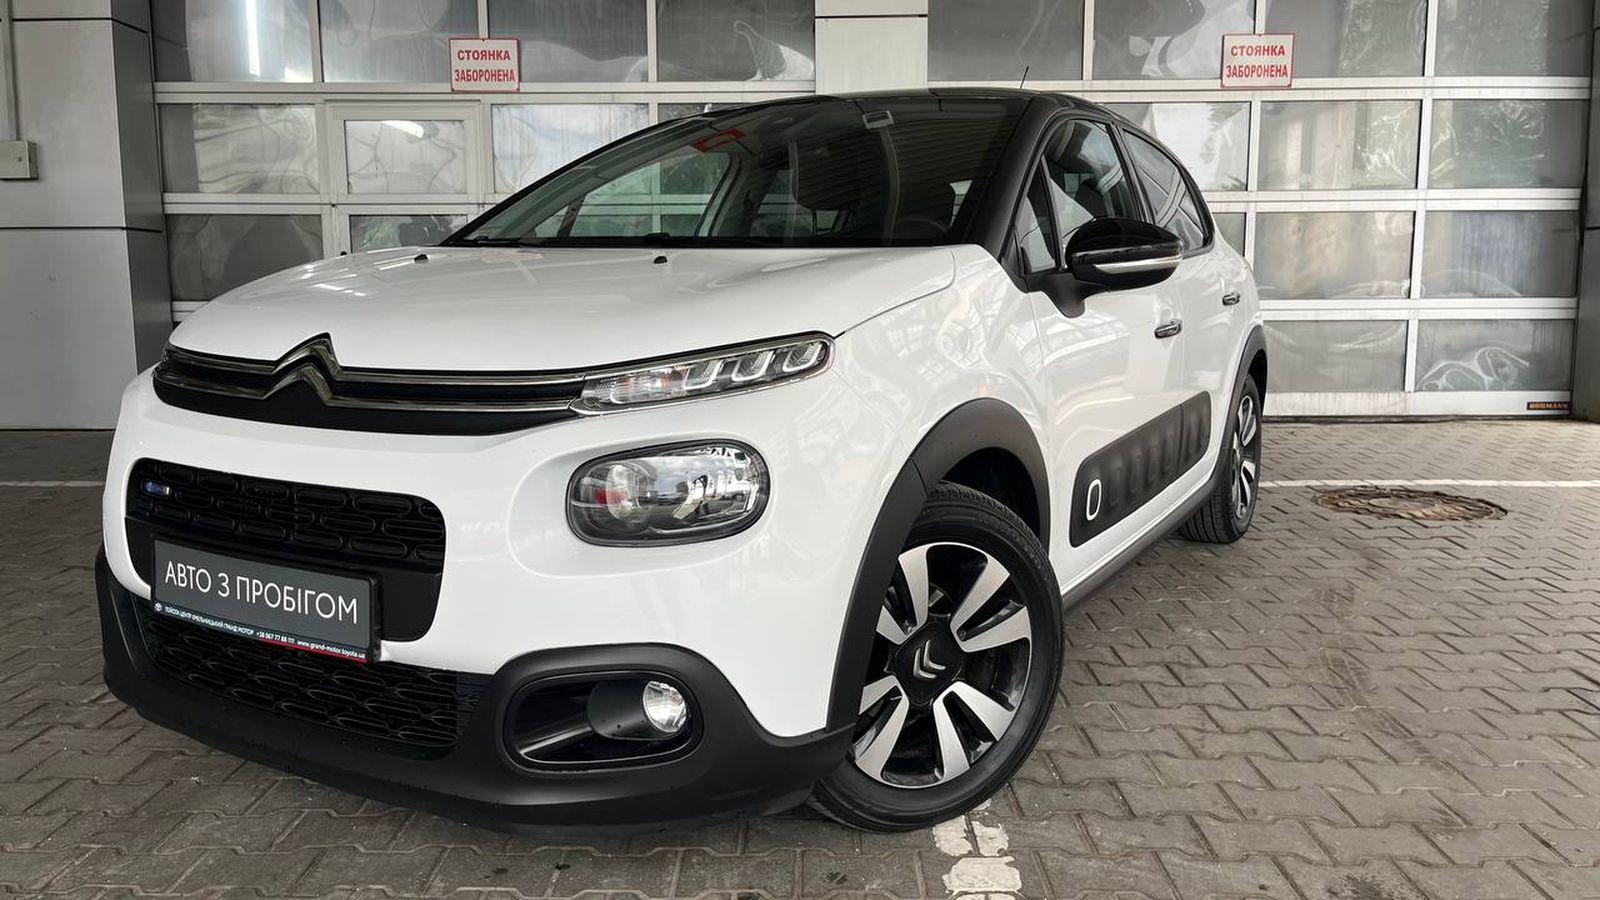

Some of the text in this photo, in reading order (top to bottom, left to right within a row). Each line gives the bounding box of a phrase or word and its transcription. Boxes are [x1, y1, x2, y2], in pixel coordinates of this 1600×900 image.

[457, 49, 511, 61] СТОЯНКА
[1231, 45, 1286, 56] СТОЯНКА
[454, 69, 516, 82] ЗАБОРОНЕНА
[1226, 64, 1289, 78] ЗАБОРОНЕНА
[165, 560, 212, 594] АВТО
[236, 575, 358, 625] ПРОБІГОМ
